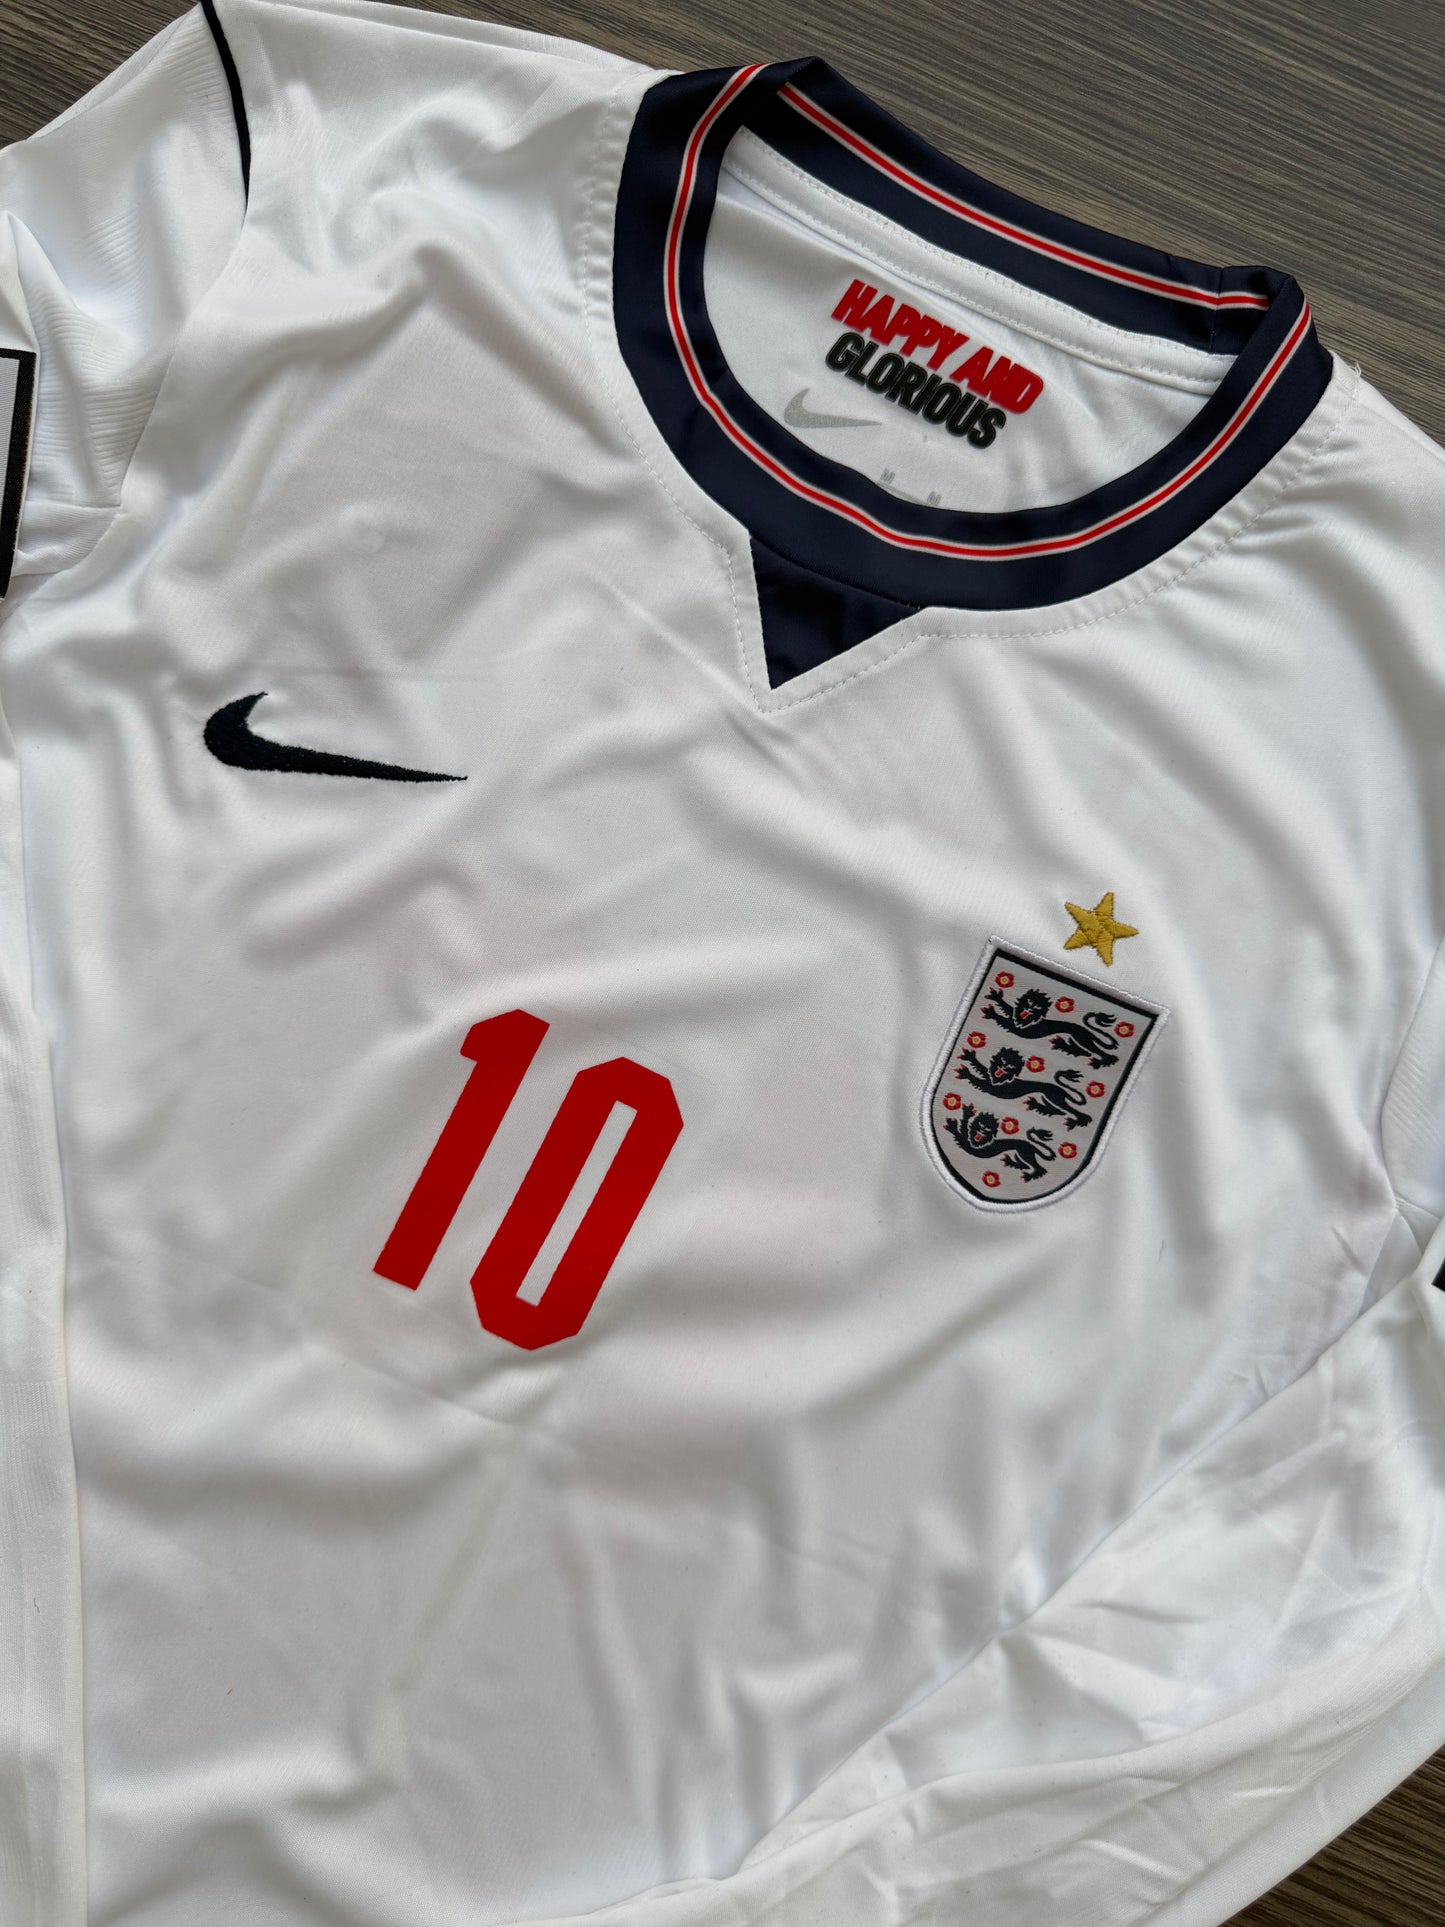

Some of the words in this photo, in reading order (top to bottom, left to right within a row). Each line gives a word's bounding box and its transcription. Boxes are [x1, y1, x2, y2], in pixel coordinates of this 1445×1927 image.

[825, 331, 1007, 449] GLORIOUS
[830, 279, 970, 371] HAPPY
[950, 346, 1044, 415] AND
[372, 1008, 684, 1351] 10
